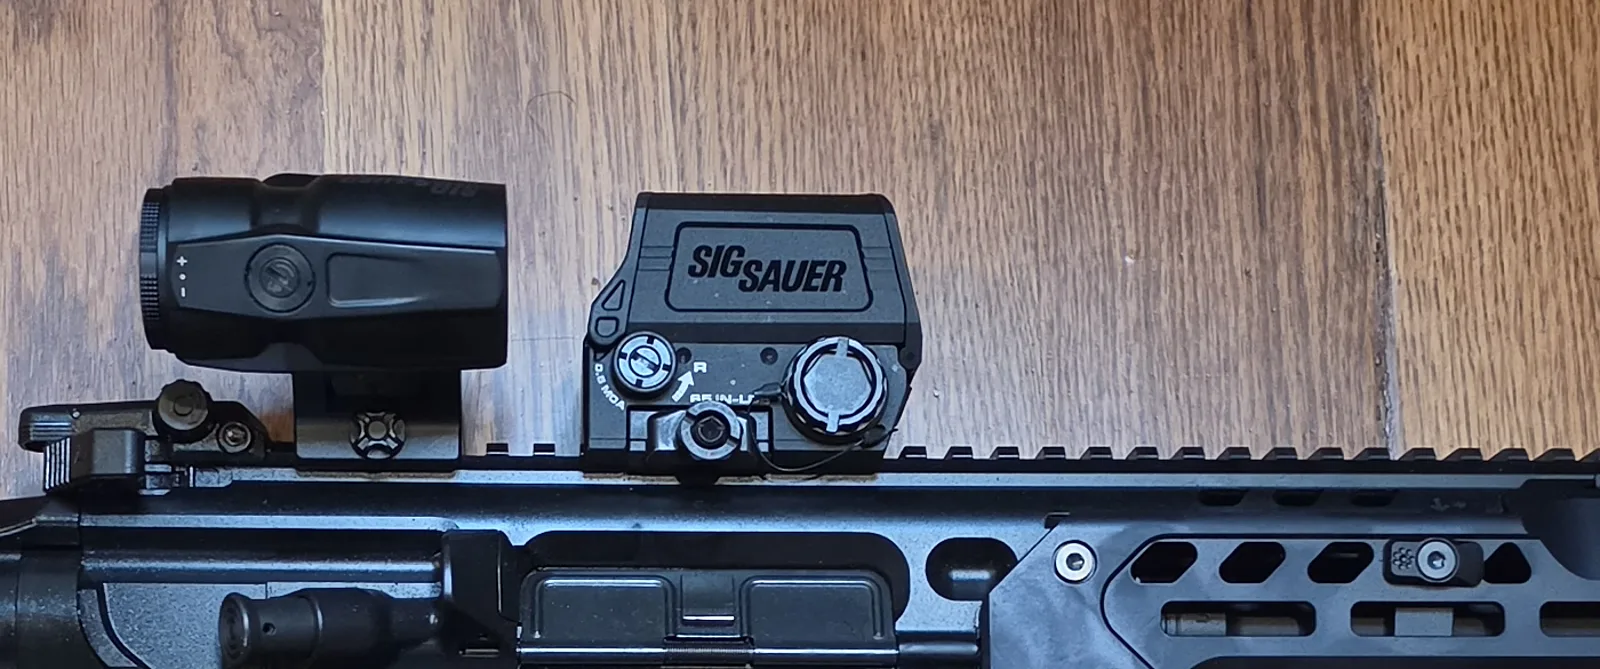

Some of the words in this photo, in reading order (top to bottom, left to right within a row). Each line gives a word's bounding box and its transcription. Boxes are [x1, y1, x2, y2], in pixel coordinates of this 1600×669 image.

[688, 245, 745, 278] SIG
[738, 260, 846, 292] SAUER
[693, 361, 707, 373] R
[601, 384, 625, 411] MOA
